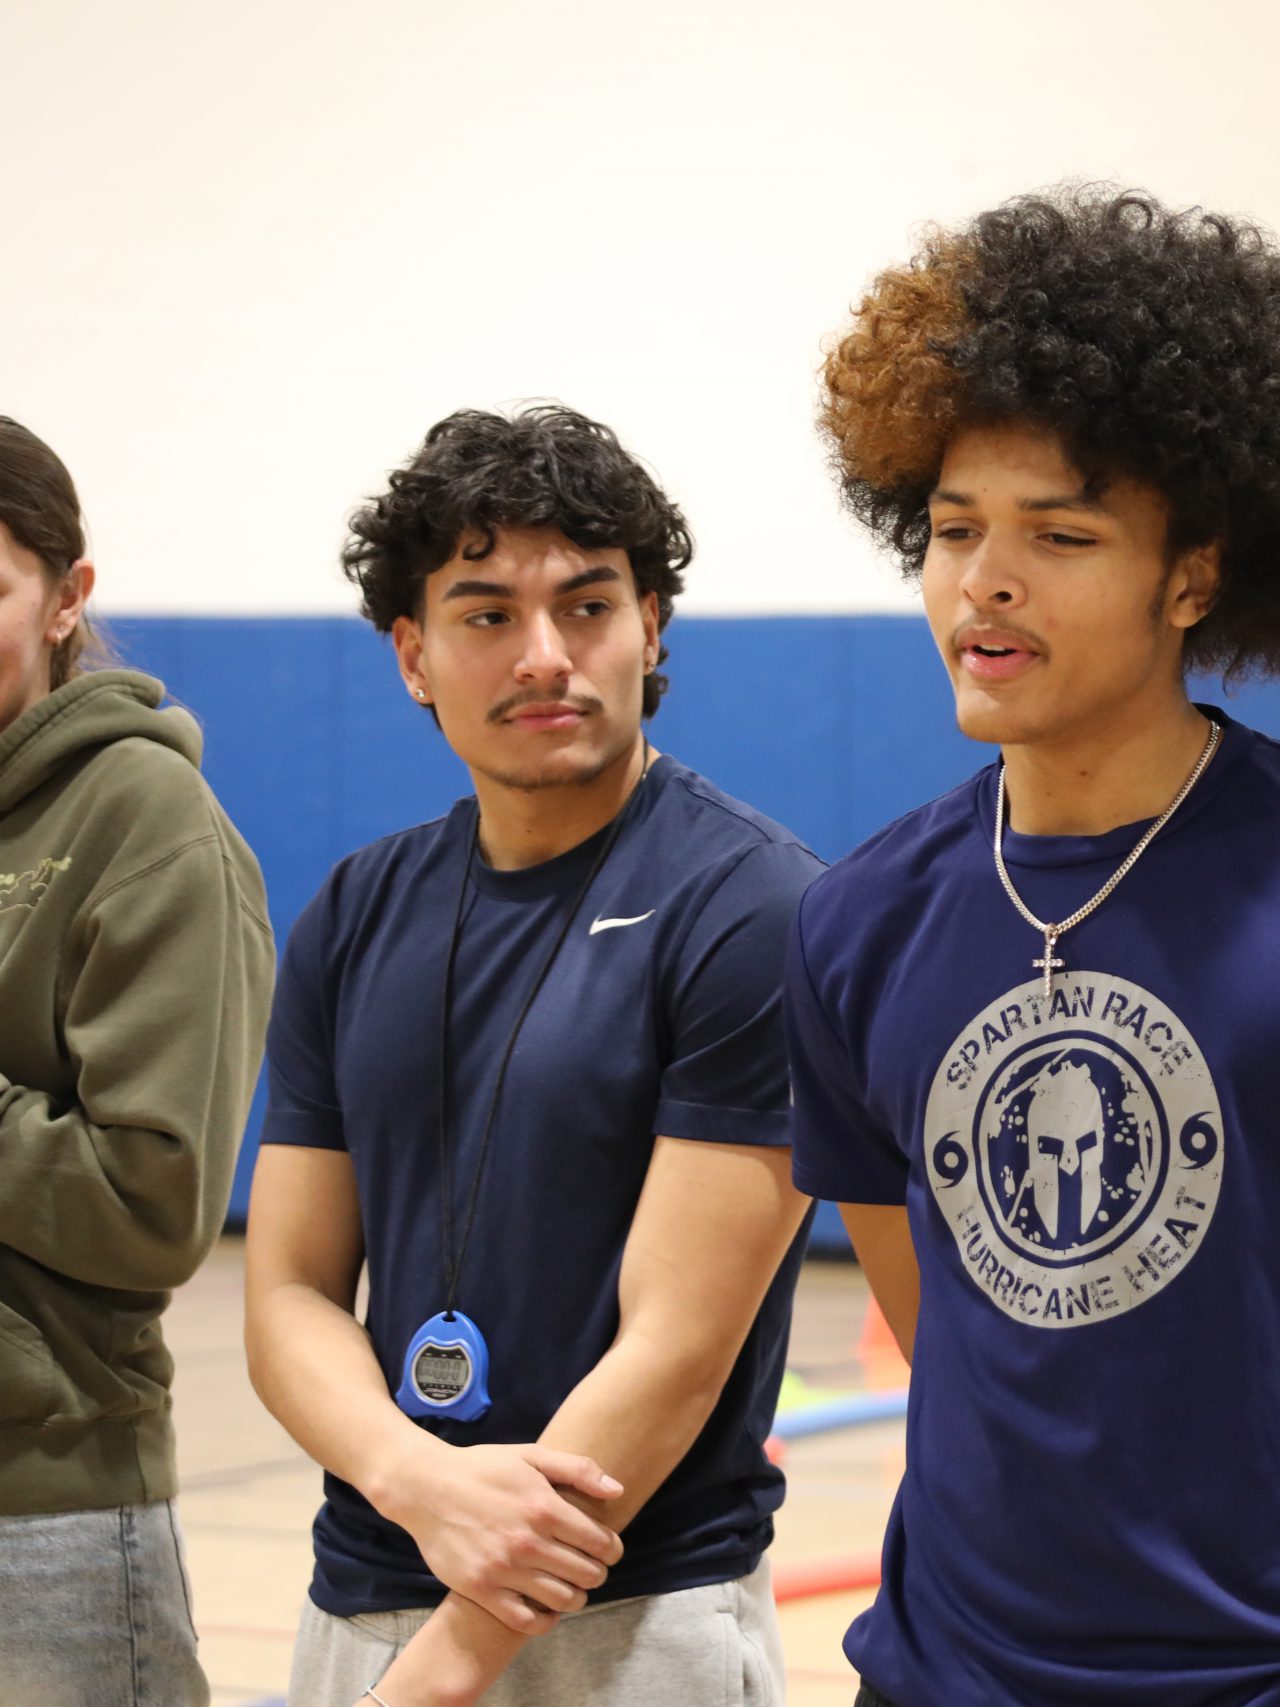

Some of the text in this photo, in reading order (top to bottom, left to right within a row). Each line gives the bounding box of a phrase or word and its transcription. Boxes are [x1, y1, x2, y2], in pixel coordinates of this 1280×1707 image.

[946, 986, 1194, 1091] SPARTAN RACE
[955, 1186, 1207, 1321] HURRICANE HEAT
